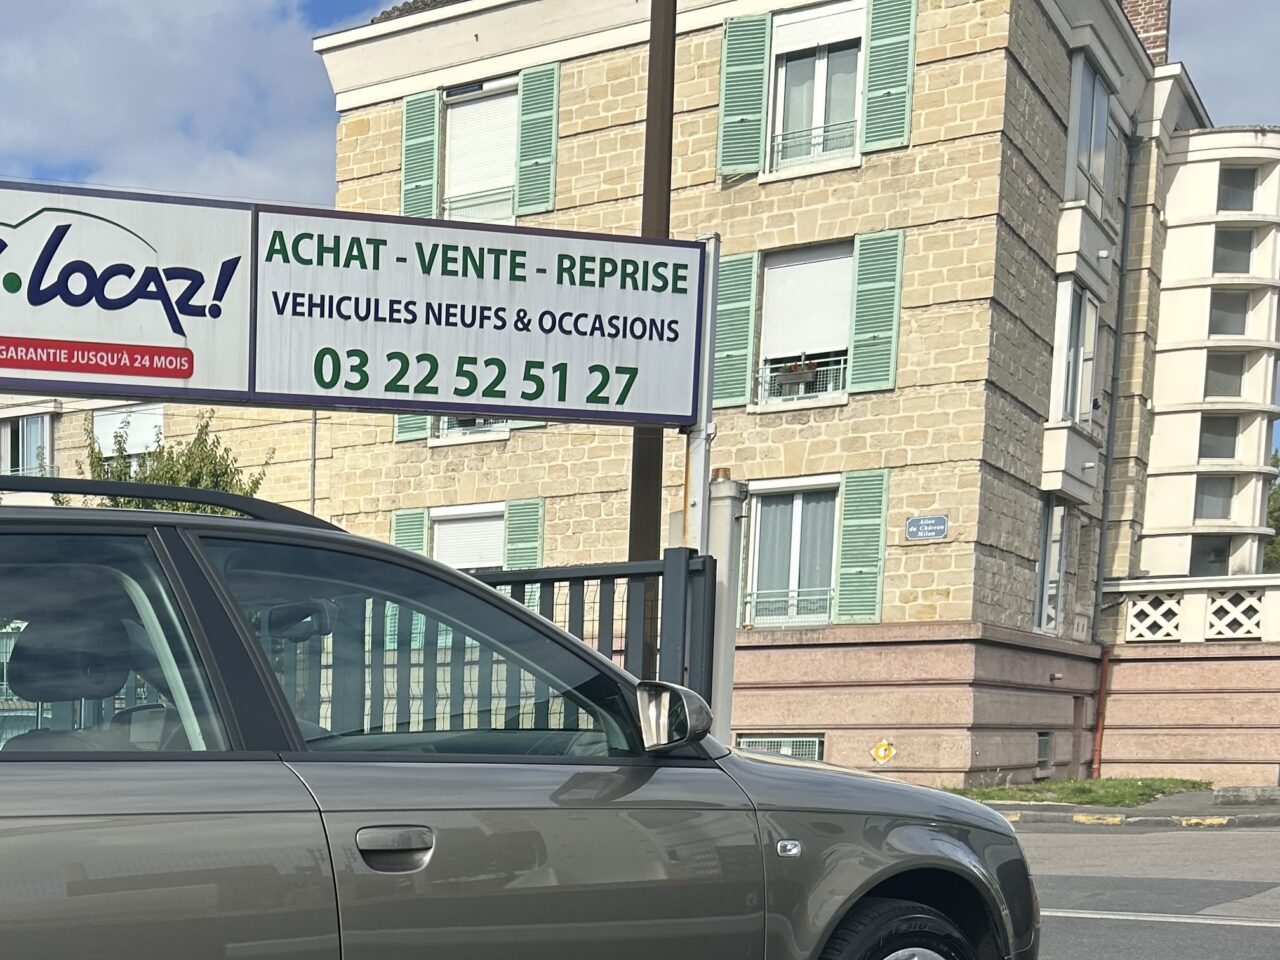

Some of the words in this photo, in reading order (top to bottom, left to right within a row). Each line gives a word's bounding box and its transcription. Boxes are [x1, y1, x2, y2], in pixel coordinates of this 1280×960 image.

[265, 230, 387, 270] ACHAT
[415, 242, 526, 282] VENTE
[557, 254, 688, 294] REPRISE
[272, 291, 417, 324] VEHICULES
[425, 302, 507, 330] NEUFS
[513, 309, 532, 332] &
[538, 310, 679, 343] OCCASIONS
[133, 355, 150, 368] 24
[153, 356, 189, 370] MOIS
[314, 347, 369, 391] 03
[384, 352, 439, 394] 22
[453, 356, 506, 398] 52
[520, 360, 568, 402] 51
[586, 364, 639, 405] 27
